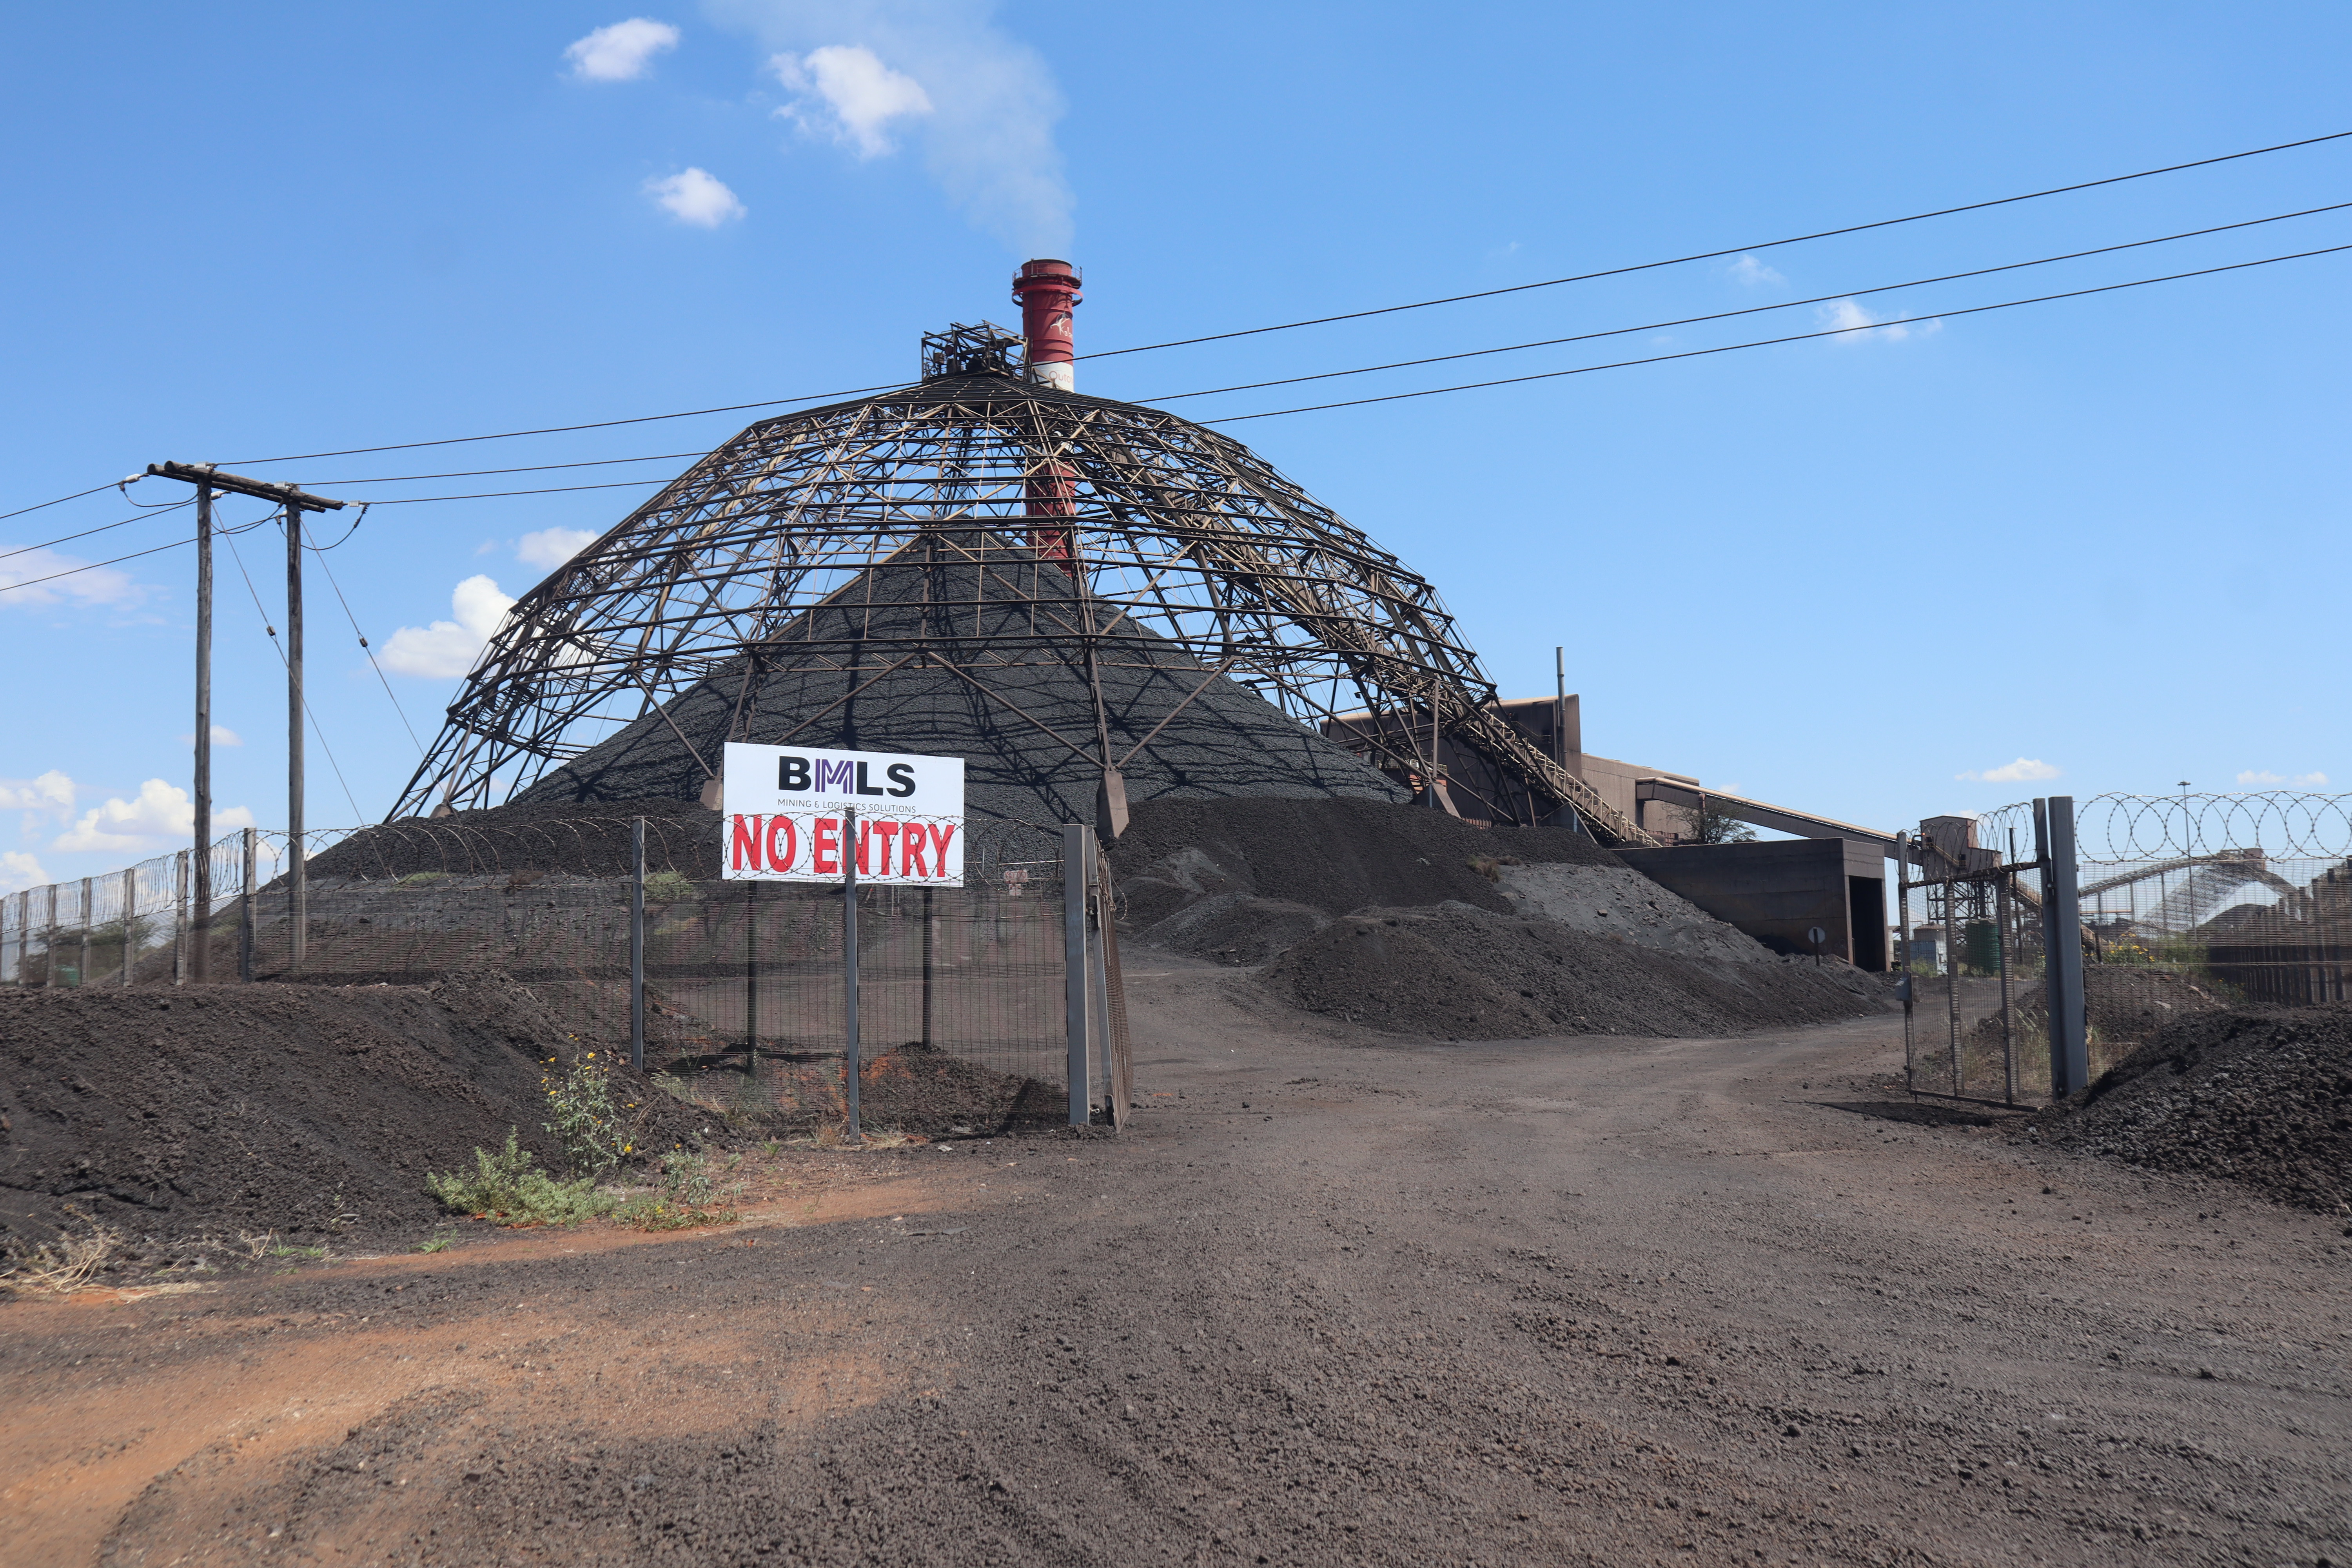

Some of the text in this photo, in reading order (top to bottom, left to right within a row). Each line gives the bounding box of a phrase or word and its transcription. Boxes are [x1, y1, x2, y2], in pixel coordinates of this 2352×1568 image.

[778, 755, 916, 798] BMLS
[778, 799, 811, 808] MINING
[823, 801, 866, 811] LOGISTICS
[869, 804, 916, 813] SOLUTIONS
[733, 814, 955, 878] NO ENTRY
